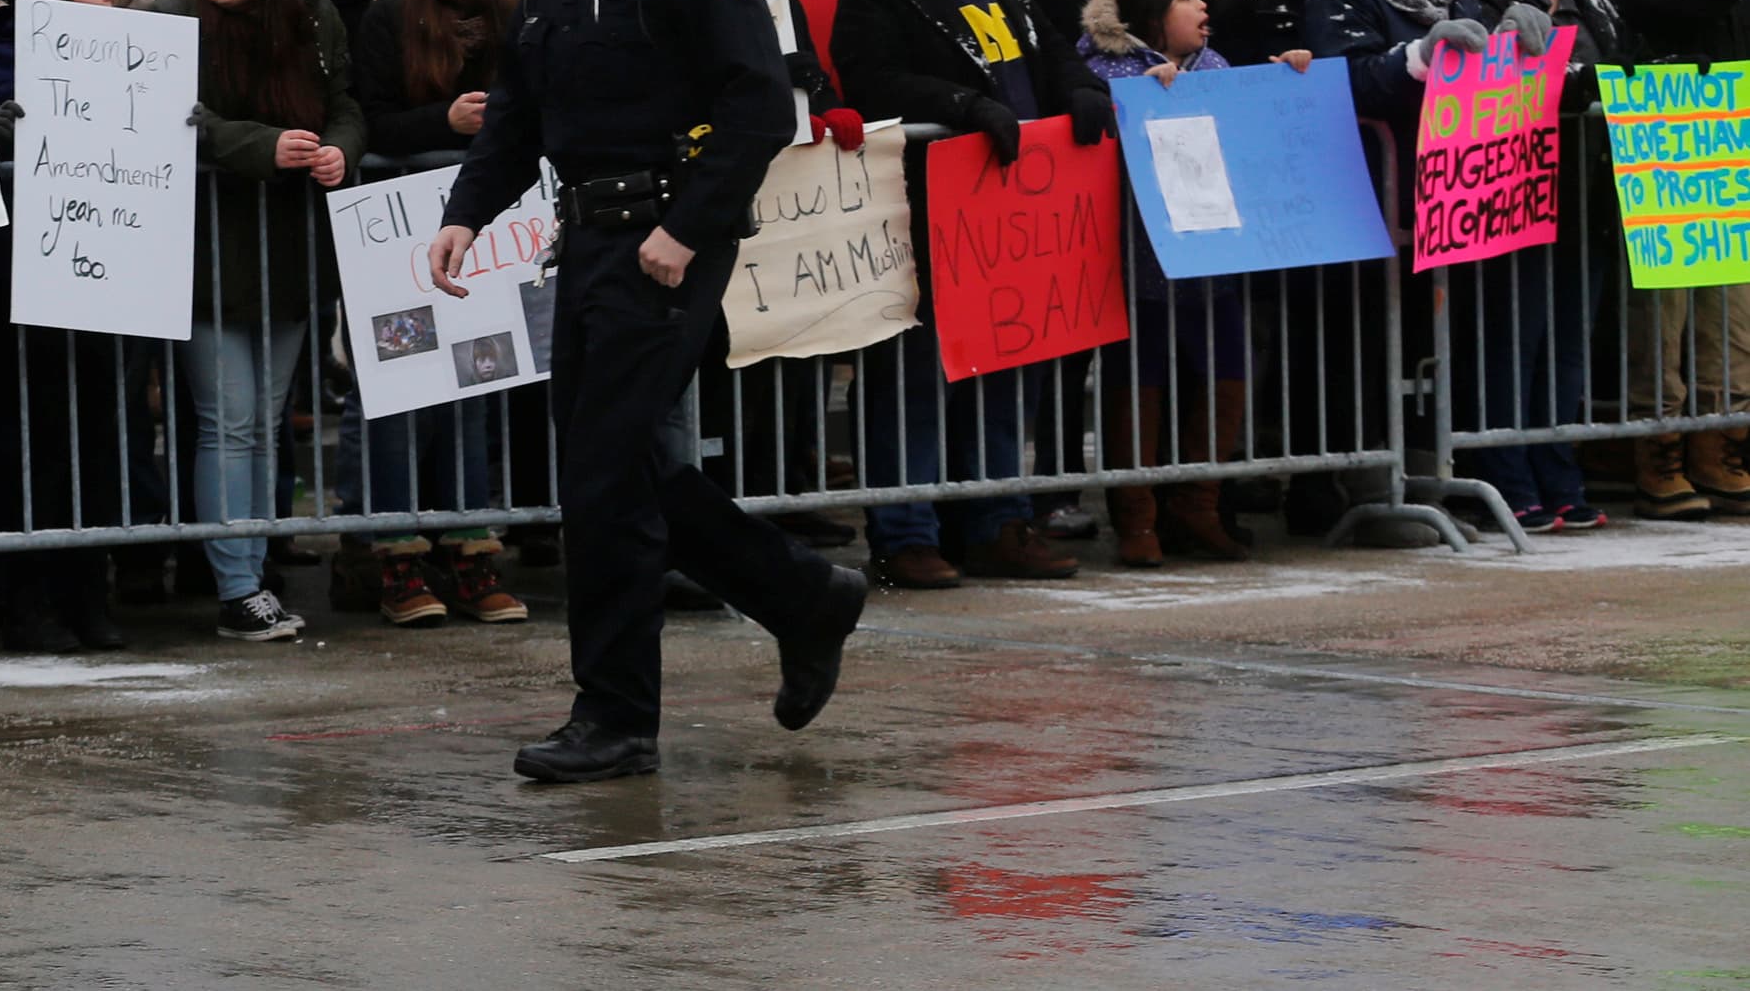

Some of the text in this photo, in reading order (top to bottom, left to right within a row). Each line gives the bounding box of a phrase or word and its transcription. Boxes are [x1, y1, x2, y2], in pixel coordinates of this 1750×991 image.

[31, 0, 180, 72] Remember
[38, 78, 93, 122] The
[1418, 71, 1548, 152] NO FEAR!
[1599, 70, 1744, 114] I CANNOT
[33, 134, 174, 191] Amendment?
[970, 144, 1055, 197] NO
[1416, 126, 1558, 205] REFUGEES ARE
[1669, 123, 1691, 162] I
[336, 191, 412, 248] Tell
[1416, 174, 1558, 261] WELCOME HERE!
[1618, 167, 1750, 213] TO PROTES
[40, 193, 143, 258] yeah me
[934, 192, 1102, 307] MUSLIM
[1627, 223, 1674, 268] THIS
[745, 219, 913, 313] I AM Muslim
[990, 260, 1113, 358] BAN
